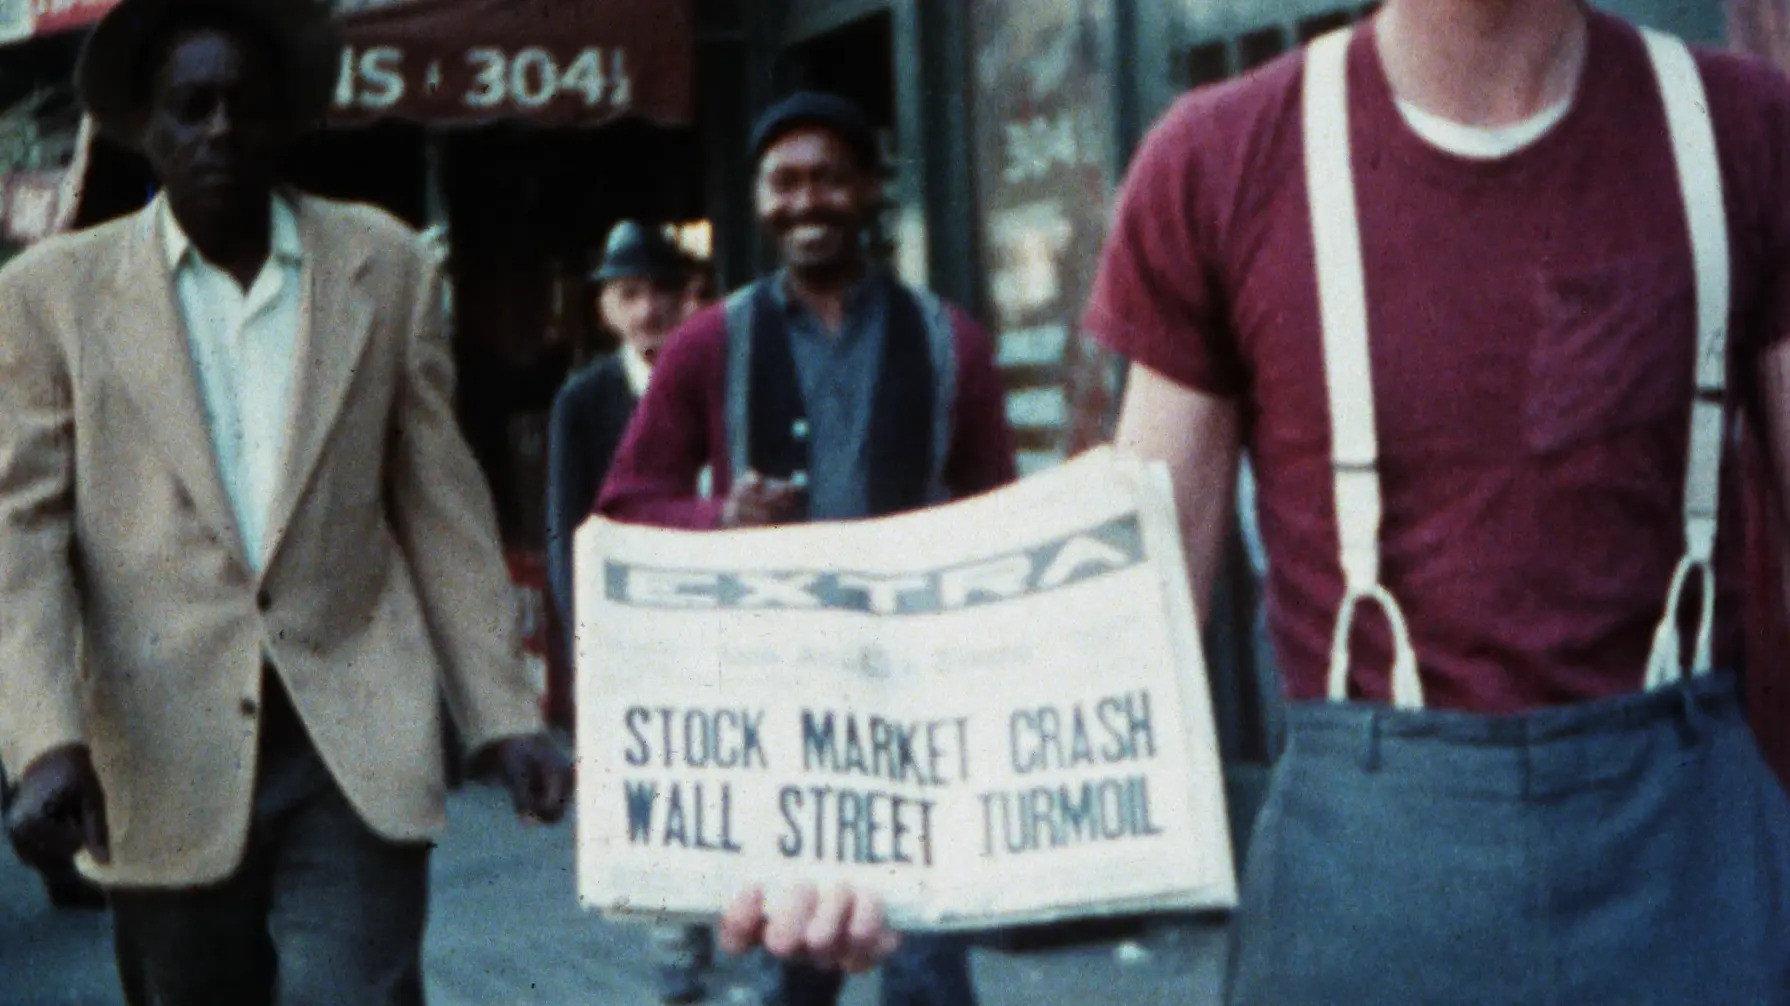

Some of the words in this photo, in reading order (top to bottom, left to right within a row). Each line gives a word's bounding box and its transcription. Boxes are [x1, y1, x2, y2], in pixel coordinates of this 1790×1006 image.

[625, 530, 1132, 613] EXTRA
[625, 707, 767, 770] STOCK
[802, 710, 968, 786] MARKET
[1011, 690, 1156, 773] CRASH
[626, 781, 741, 852] WALL
[780, 785, 935, 865] STREET
[980, 776, 1162, 857] TURMOIL
